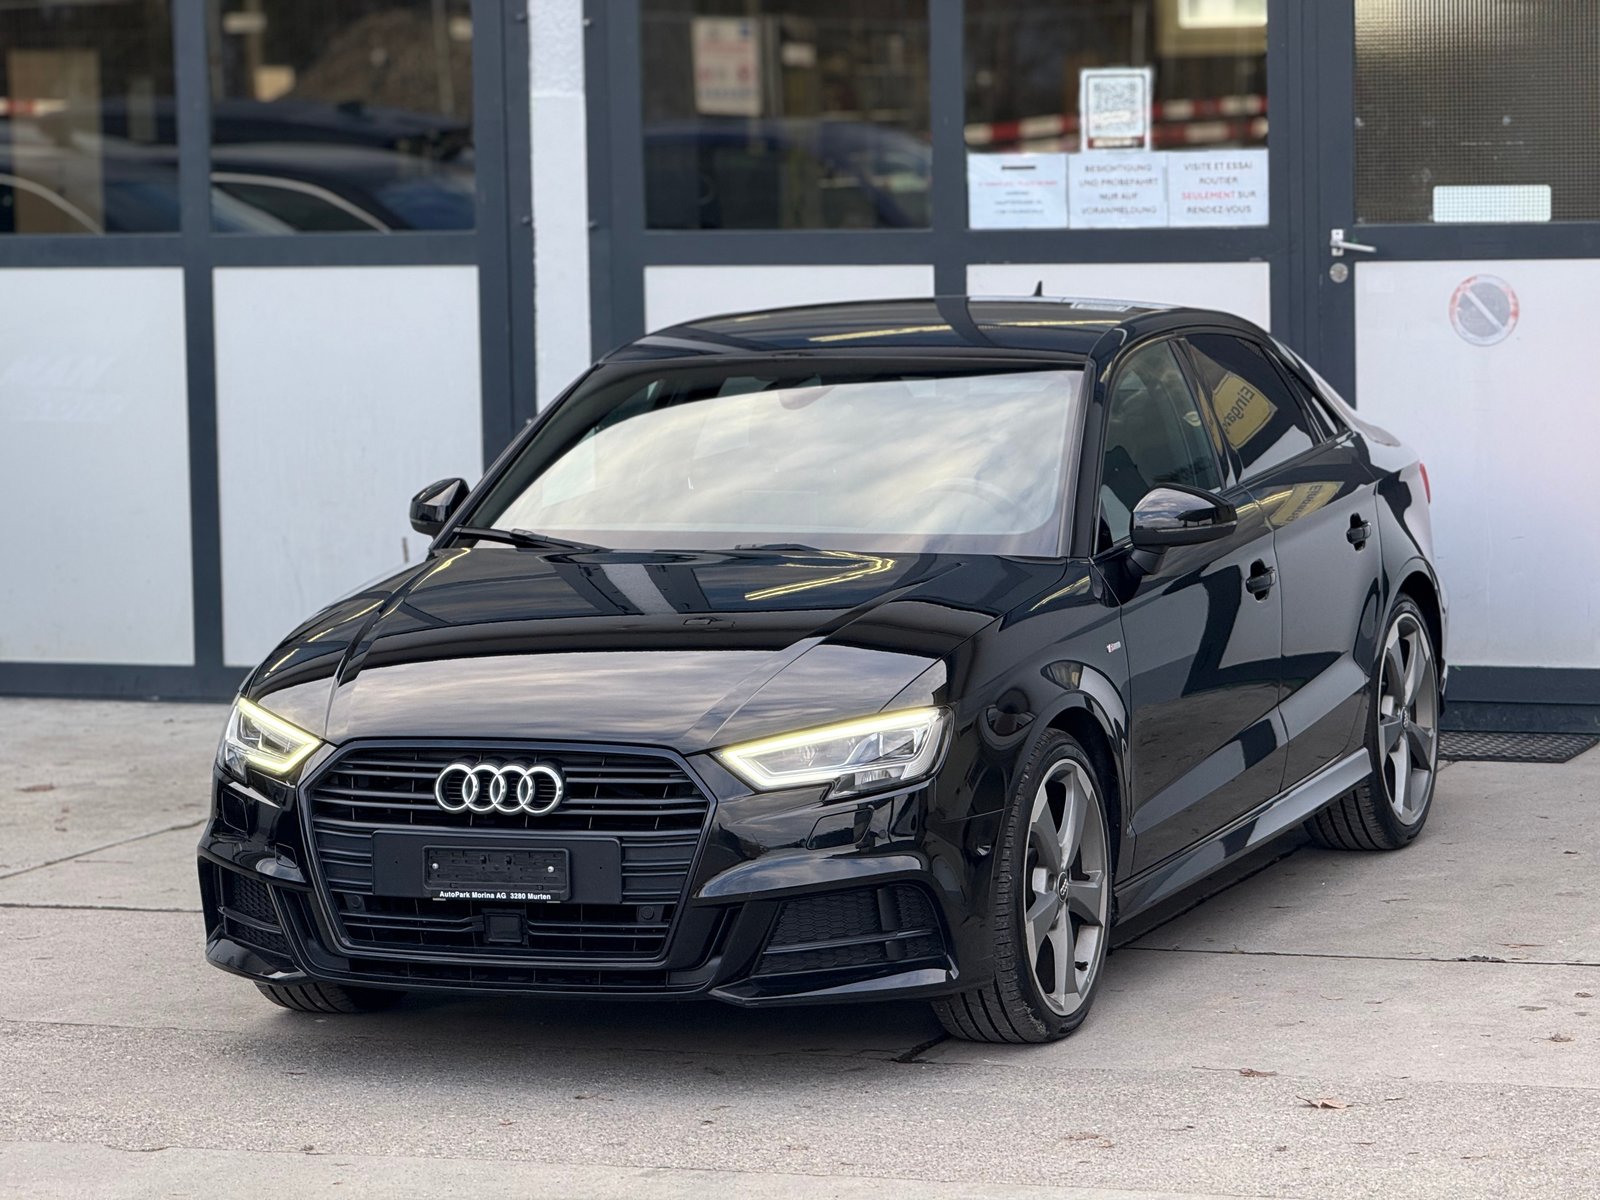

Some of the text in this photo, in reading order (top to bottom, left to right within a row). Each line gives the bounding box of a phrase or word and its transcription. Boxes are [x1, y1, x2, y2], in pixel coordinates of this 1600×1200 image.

[1199, 176, 1238, 185] ROUTIER
[1183, 190, 1256, 200] SEULEMENT SUR
[439, 890, 470, 899] AutoPark
[472, 891, 495, 899] Morina
[510, 892, 526, 900] 3280
[528, 892, 551, 900] Murten
